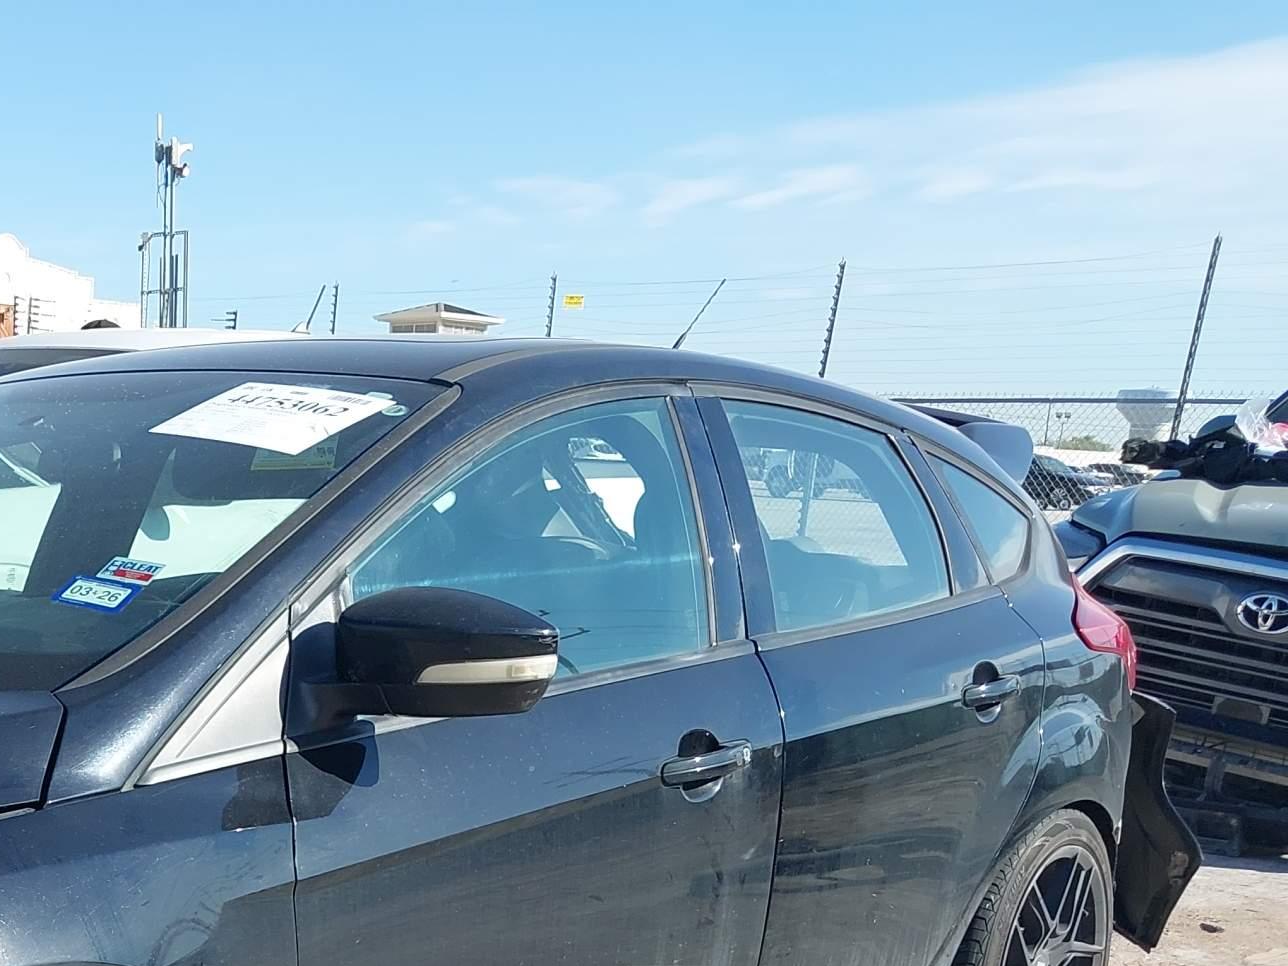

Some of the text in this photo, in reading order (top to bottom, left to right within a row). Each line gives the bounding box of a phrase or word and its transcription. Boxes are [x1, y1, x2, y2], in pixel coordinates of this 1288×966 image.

[228, 394, 350, 417] 44753062
[70, 585, 122, 602] 03 26
